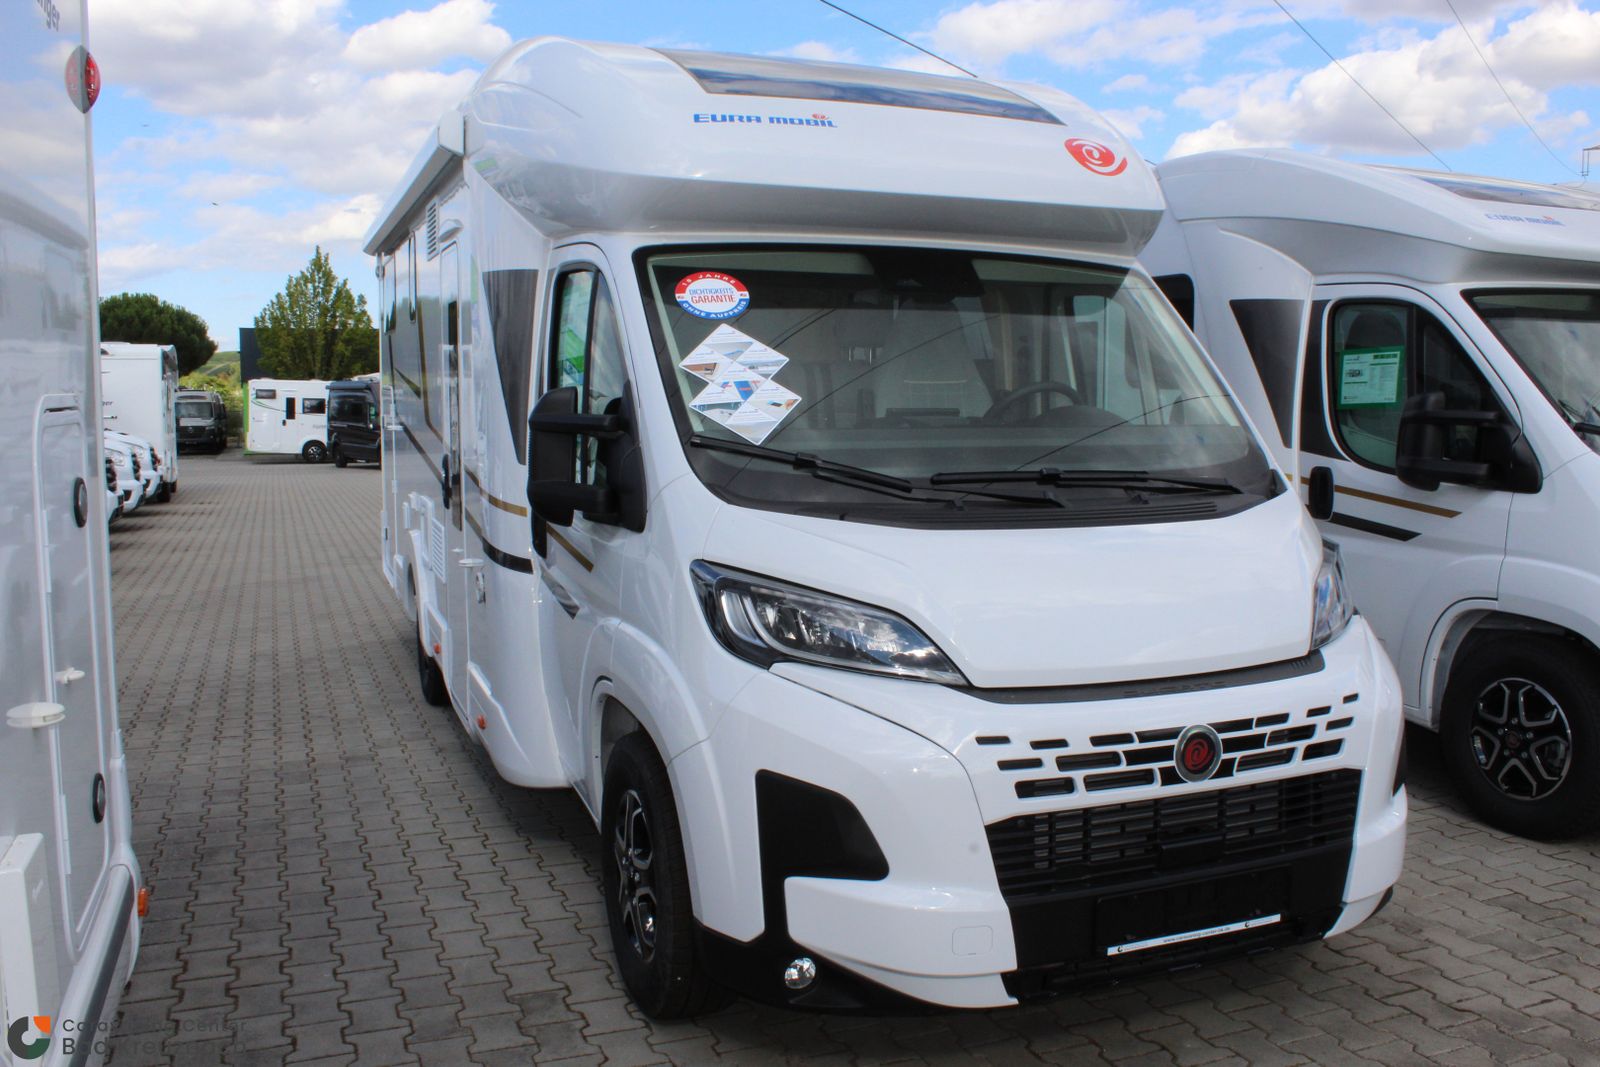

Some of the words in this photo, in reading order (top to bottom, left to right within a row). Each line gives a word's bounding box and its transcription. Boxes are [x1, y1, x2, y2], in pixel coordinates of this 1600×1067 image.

[693, 113, 762, 123] EURA
[682, 278, 692, 286] 15
[698, 273, 736, 284] JAHRE
[689, 287, 734, 296] DICHTIGKEITS
[691, 294, 736, 304] GARANTIE
[683, 302, 706, 317] OHNE
[709, 300, 747, 318] AUFPREIS
